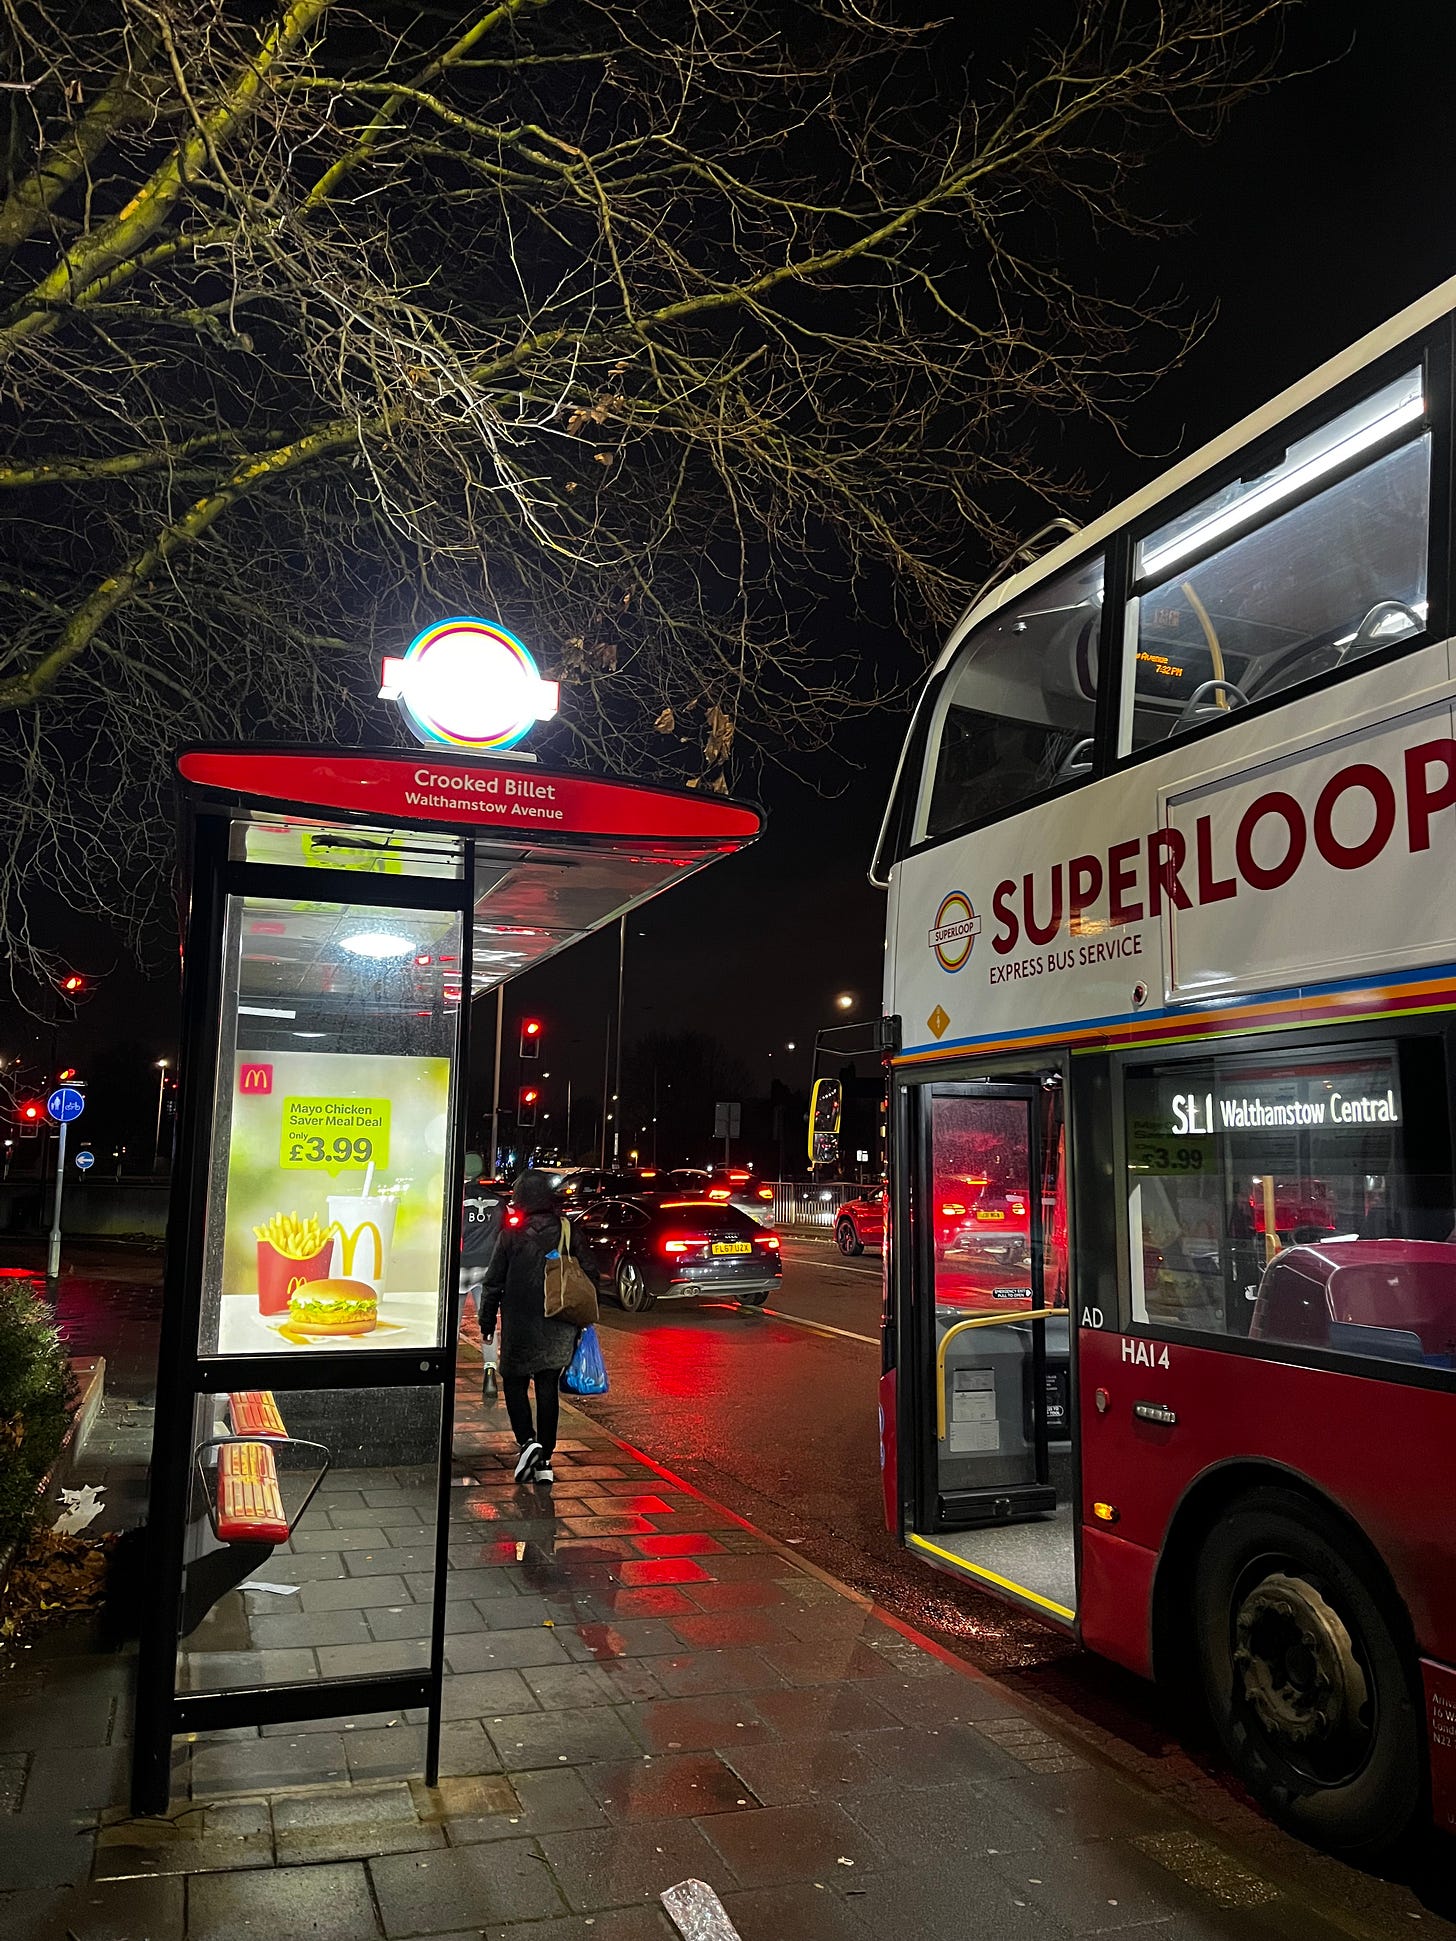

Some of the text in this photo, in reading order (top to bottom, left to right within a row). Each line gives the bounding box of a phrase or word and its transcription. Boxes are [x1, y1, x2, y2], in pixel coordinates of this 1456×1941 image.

[414, 769, 556, 800] Crooked Billet
[405, 792, 564, 820] Walthamstow Avenue
[991, 738, 1456, 955] SUPERLOOP
[935, 921, 974, 942] SUPERLOOP
[990, 934, 1143, 985] EXPRESS BUS SERVICE
[289, 1115, 382, 1127] Saver Meal Deal
[290, 1103, 372, 1116] Mayo Chicken
[1171, 1093, 1214, 1135] SL1
[1220, 1098, 1325, 1128] Walthamstow
[1330, 1090, 1398, 1123] Central
[289, 1131, 308, 1141] Only
[289, 1137, 373, 1162] £3.99
[468, 1212, 492, 1222] BOY
[1082, 1306, 1104, 1329] AD
